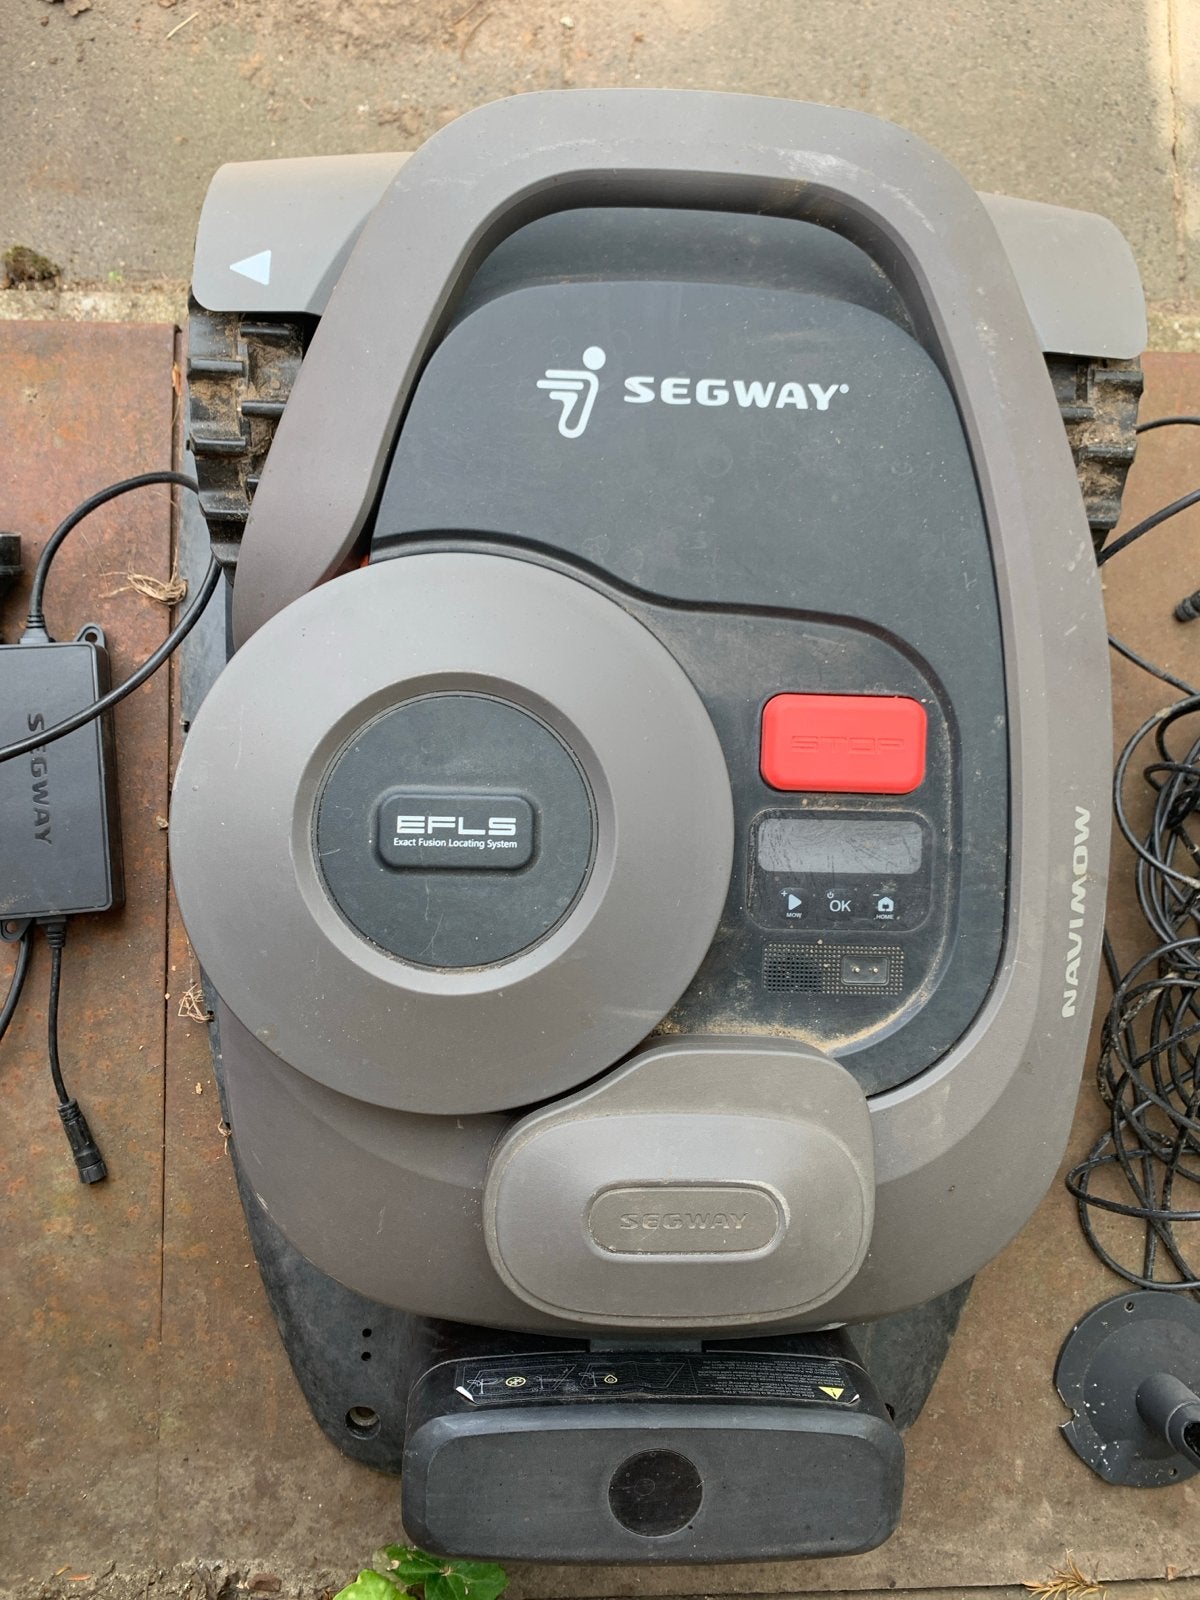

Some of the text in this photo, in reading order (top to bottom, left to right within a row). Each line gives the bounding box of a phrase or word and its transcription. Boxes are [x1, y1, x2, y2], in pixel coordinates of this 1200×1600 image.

[791, 735, 905, 756] STOP
[27, 712, 52, 845] SGWAY
[396, 815, 517, 836] EFLS
[393, 837, 518, 850] Exact Fusion Locating System
[829, 900, 852, 912] OK
[1061, 805, 1091, 1018] NAVIMOW
[620, 1212, 750, 1230] SEGWAY
